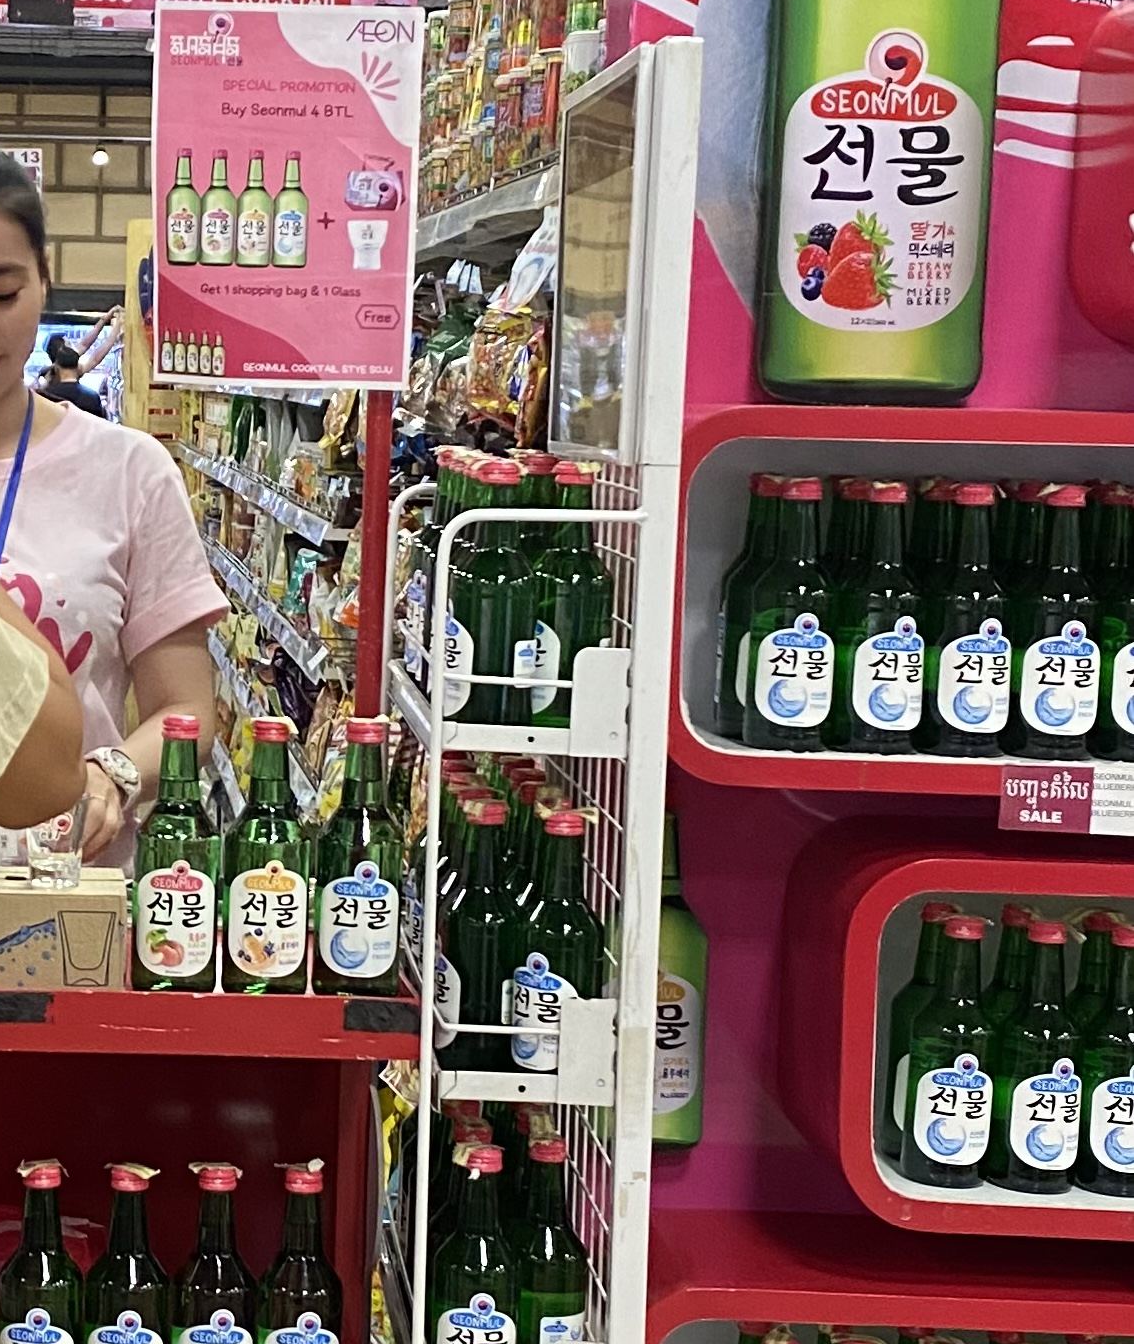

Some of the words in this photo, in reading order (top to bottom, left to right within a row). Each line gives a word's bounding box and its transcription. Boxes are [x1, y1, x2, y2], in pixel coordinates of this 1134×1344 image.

[222, 79, 276, 93] SPECIAL
[280, 80, 356, 94] PROMOTION
[221, 102, 249, 119] Buy
[251, 103, 308, 118] Seonmul
[311, 104, 320, 118] 4
[324, 104, 354, 119] BTL
[821, 87, 947, 117] SEONMUL
[20, 150, 40, 163] 13
[802, 123, 965, 206] 선물
[907, 271, 951, 280] BERRY
[908, 262, 953, 271] STRAW
[200, 282, 222, 295] Get
[231, 283, 283, 298] shopping
[286, 284, 308, 299] bag
[310, 285, 320, 297] &
[330, 285, 362, 298] Glass
[906, 297, 950, 306] BERRY
[907, 288, 951, 297] MIXED
[363, 310, 392, 324] Free
[243, 362, 289, 373] SEONMUL
[290, 363, 339, 374] COCKTAIL
[369, 364, 393, 375] SOJU
[768, 647, 828, 680] 선물
[868, 651, 923, 683] 선물
[953, 654, 1010, 687] 선물
[1034, 655, 1096, 688] 선물
[1019, 810, 1063, 824] SALE
[146, 892, 206, 928] 선물
[240, 892, 299, 929] 선물
[330, 897, 391, 930] 선물
[927, 1086, 988, 1120] 선물
[1025, 1093, 1080, 1124] 선물
